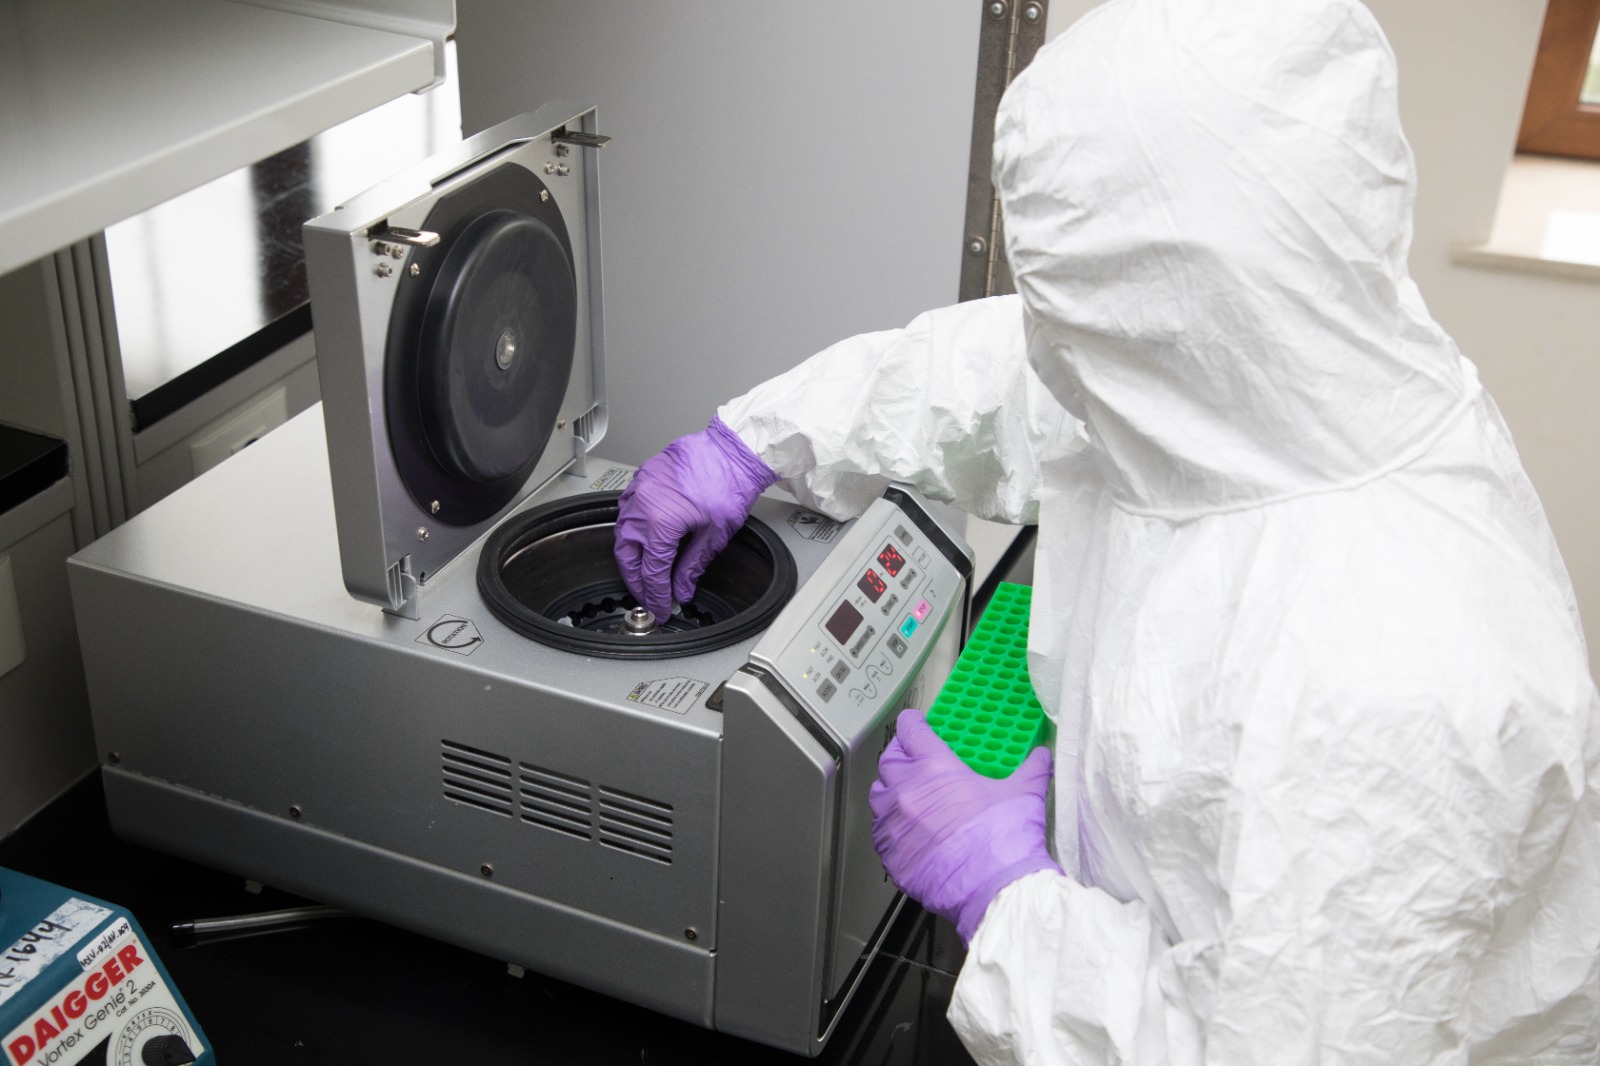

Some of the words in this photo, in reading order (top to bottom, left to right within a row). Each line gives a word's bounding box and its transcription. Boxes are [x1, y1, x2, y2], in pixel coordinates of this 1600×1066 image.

[879, 546, 903, 576] 24
[441, 623, 468, 644] ROTATION
[8, 944, 145, 1066] DAIGGER
[37, 1028, 84, 1066] Vortex
[126, 979, 138, 995] 2
[122, 1010, 152, 1039] VORTEX
